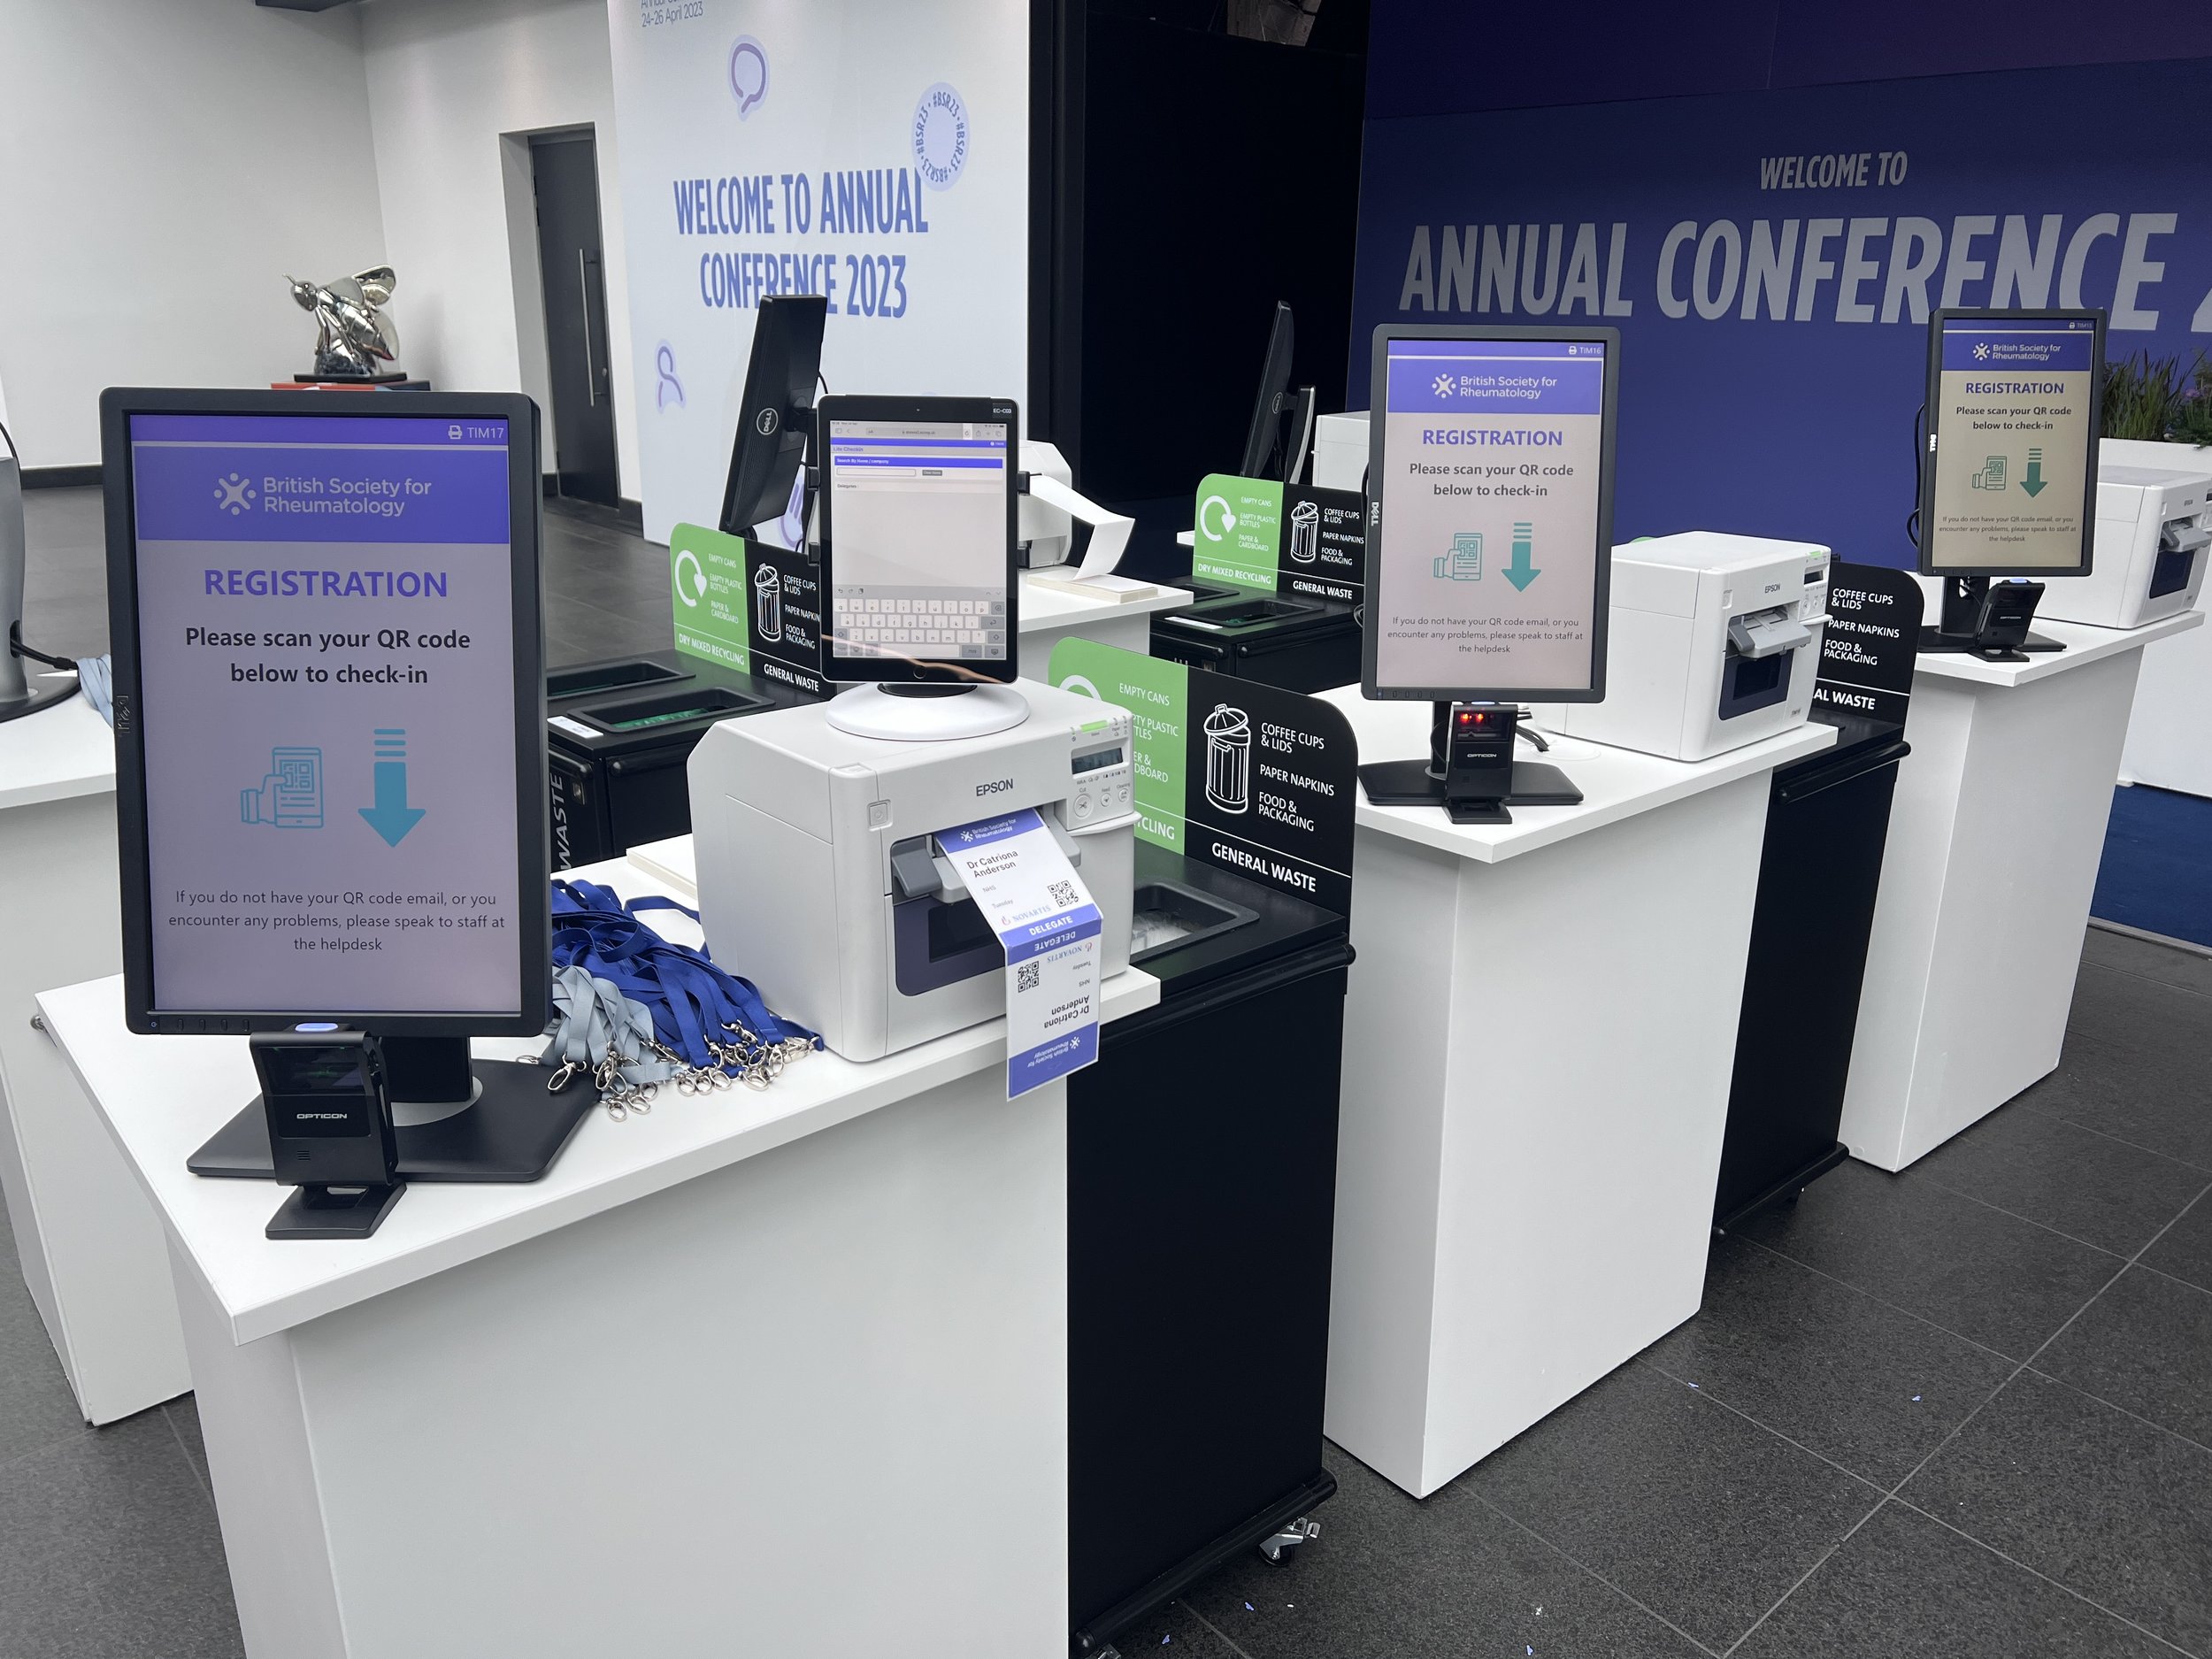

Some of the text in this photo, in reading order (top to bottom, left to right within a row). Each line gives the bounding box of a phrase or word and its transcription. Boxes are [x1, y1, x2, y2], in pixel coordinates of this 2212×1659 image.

[642, 9, 664, 27] 24-26
[665, 5, 682, 25] April
[684, 1, 703, 19] 2023
[933, 91, 960, 118] #BSR23
[916, 105, 929, 155] #BSR23
[950, 122, 964, 172] #BSR23
[922, 158, 949, 182] #BSR23
[1761, 150, 1908, 189] WELCOME TO
[673, 167, 928, 234] WELCOME TO ANNUAL
[1399, 212, 2178, 331] ANNUAL CONFERENCE
[701, 253, 907, 319] CONFERENCE 2023
[1993, 352, 2050, 361] Rheumatology
[2019, 344, 2049, 353] Society
[1460, 376, 1557, 388] British Society for
[1966, 382, 2064, 394] REGISTRATION
[1460, 388, 1541, 399] Rheumatology
[2033, 407, 2047, 416] QR
[467, 426, 504, 441] TIM17
[1973, 421, 2001, 430] below
[2016, 421, 2053, 430] check-in
[1423, 430, 1563, 446] REGISTRATION
[1409, 464, 1449, 474] Please
[1486, 466, 1517, 478] your
[1519, 465, 1539, 476] QR
[1542, 465, 1574, 476] code
[264, 477, 432, 497] British Society for
[1433, 485, 1548, 496] below to check-in
[264, 497, 405, 517] Rheumatology
[1324, 508, 1345, 518] COFFEE
[1340, 534, 1364, 544] NAPKINS
[1321, 555, 1352, 566] PACKAGING
[1322, 547, 1343, 557] FOOD &
[205, 570, 448, 597] REGISTRATION
[1198, 564, 1271, 585] DRY MIXED RECYCLING
[1293, 580, 1352, 600] GENERAL WASTE
[1764, 583, 1780, 594] EPSON
[1832, 588, 1893, 605] COFFEE CUPS
[1832, 596, 1862, 611] & LIDS
[1828, 618, 1901, 639] PAPER NAPKINS
[186, 628, 471, 652] Please scan your QR code
[679, 634, 745, 665] DRY MIXED RECYCLING
[1824, 639, 1862, 655] FOOD &
[1824, 648, 1878, 665] PACKAGING
[230, 664, 428, 683] below to check-in
[764, 664, 819, 692] GENERAL WASTE
[1118, 683, 1170, 706] EMPTY CANS
[1832, 690, 1876, 710] WASTE
[1133, 713, 1179, 736] PTY PLASTIC
[1133, 726, 1152, 740] TLES
[1261, 722, 1325, 750] COFFEE CUPS
[1261, 734, 1293, 754] & LIDS
[1134, 763, 1168, 782] DBOARD
[1260, 764, 1334, 796] PAPER NAPKINS
[976, 779, 1014, 796] EPSON
[1259, 792, 1297, 814] FOOD &
[550, 772, 572, 871] WASTE
[1258, 804, 1315, 832] PACKAGING
[1138, 817, 1175, 841] CLING
[966, 849, 1018, 870] Dr Catriona
[973, 861, 1016, 878] Anderson
[1212, 842, 1317, 893] GENERAL WASTE
[982, 885, 996, 894] NHS
[176, 891, 495, 909] If you do not have your QR code email, or you
[992, 898, 1014, 910] Tuesday
[168, 915, 504, 930] encounter any problems, please speak to staff at
[1011, 904, 1051, 922] NOVARTIS
[1029, 916, 1072, 936] DELEGATE
[294, 938, 382, 954] the helpdesk
[1034, 931, 1076, 952] DELEGATE
[1047, 945, 1082, 964] NOVARTIS
[1051, 995, 1090, 1016] Anderson
[1044, 1005, 1090, 1029] Dr Catriona
